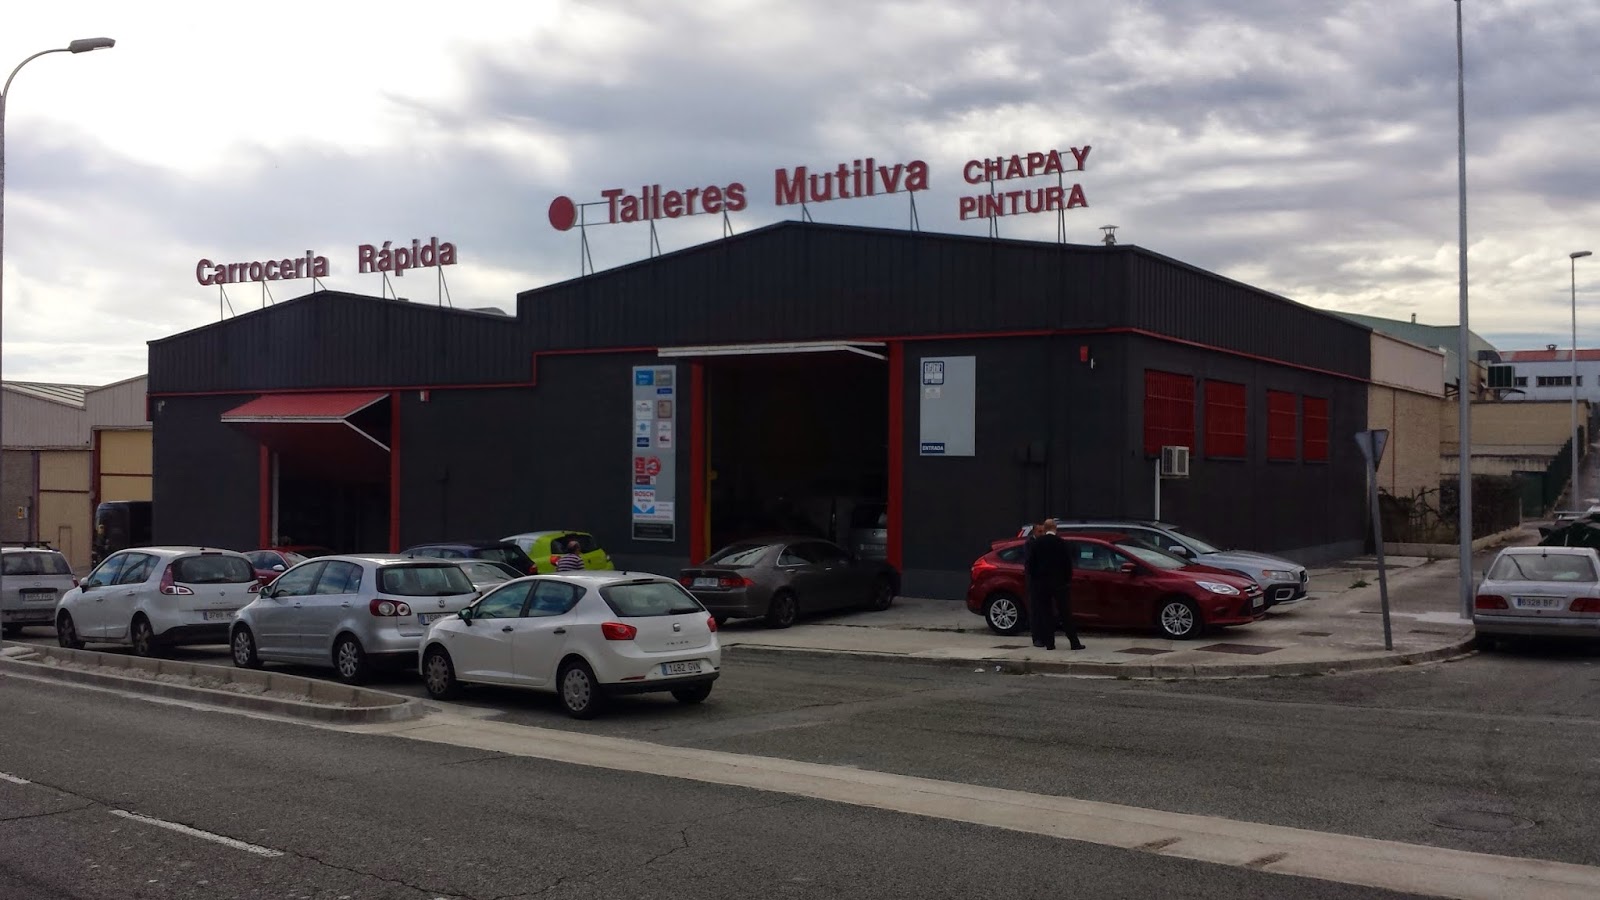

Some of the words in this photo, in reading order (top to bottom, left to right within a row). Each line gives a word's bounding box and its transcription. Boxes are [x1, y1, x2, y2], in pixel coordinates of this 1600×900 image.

[963, 150, 1064, 185] CHAPA
[1070, 145, 1092, 171] Y
[601, 181, 748, 224] Talleres
[774, 157, 930, 206] Mutilva
[959, 183, 1088, 220] PINTURA
[196, 249, 330, 286] Carroceria
[358, 236, 458, 277] Rápida
